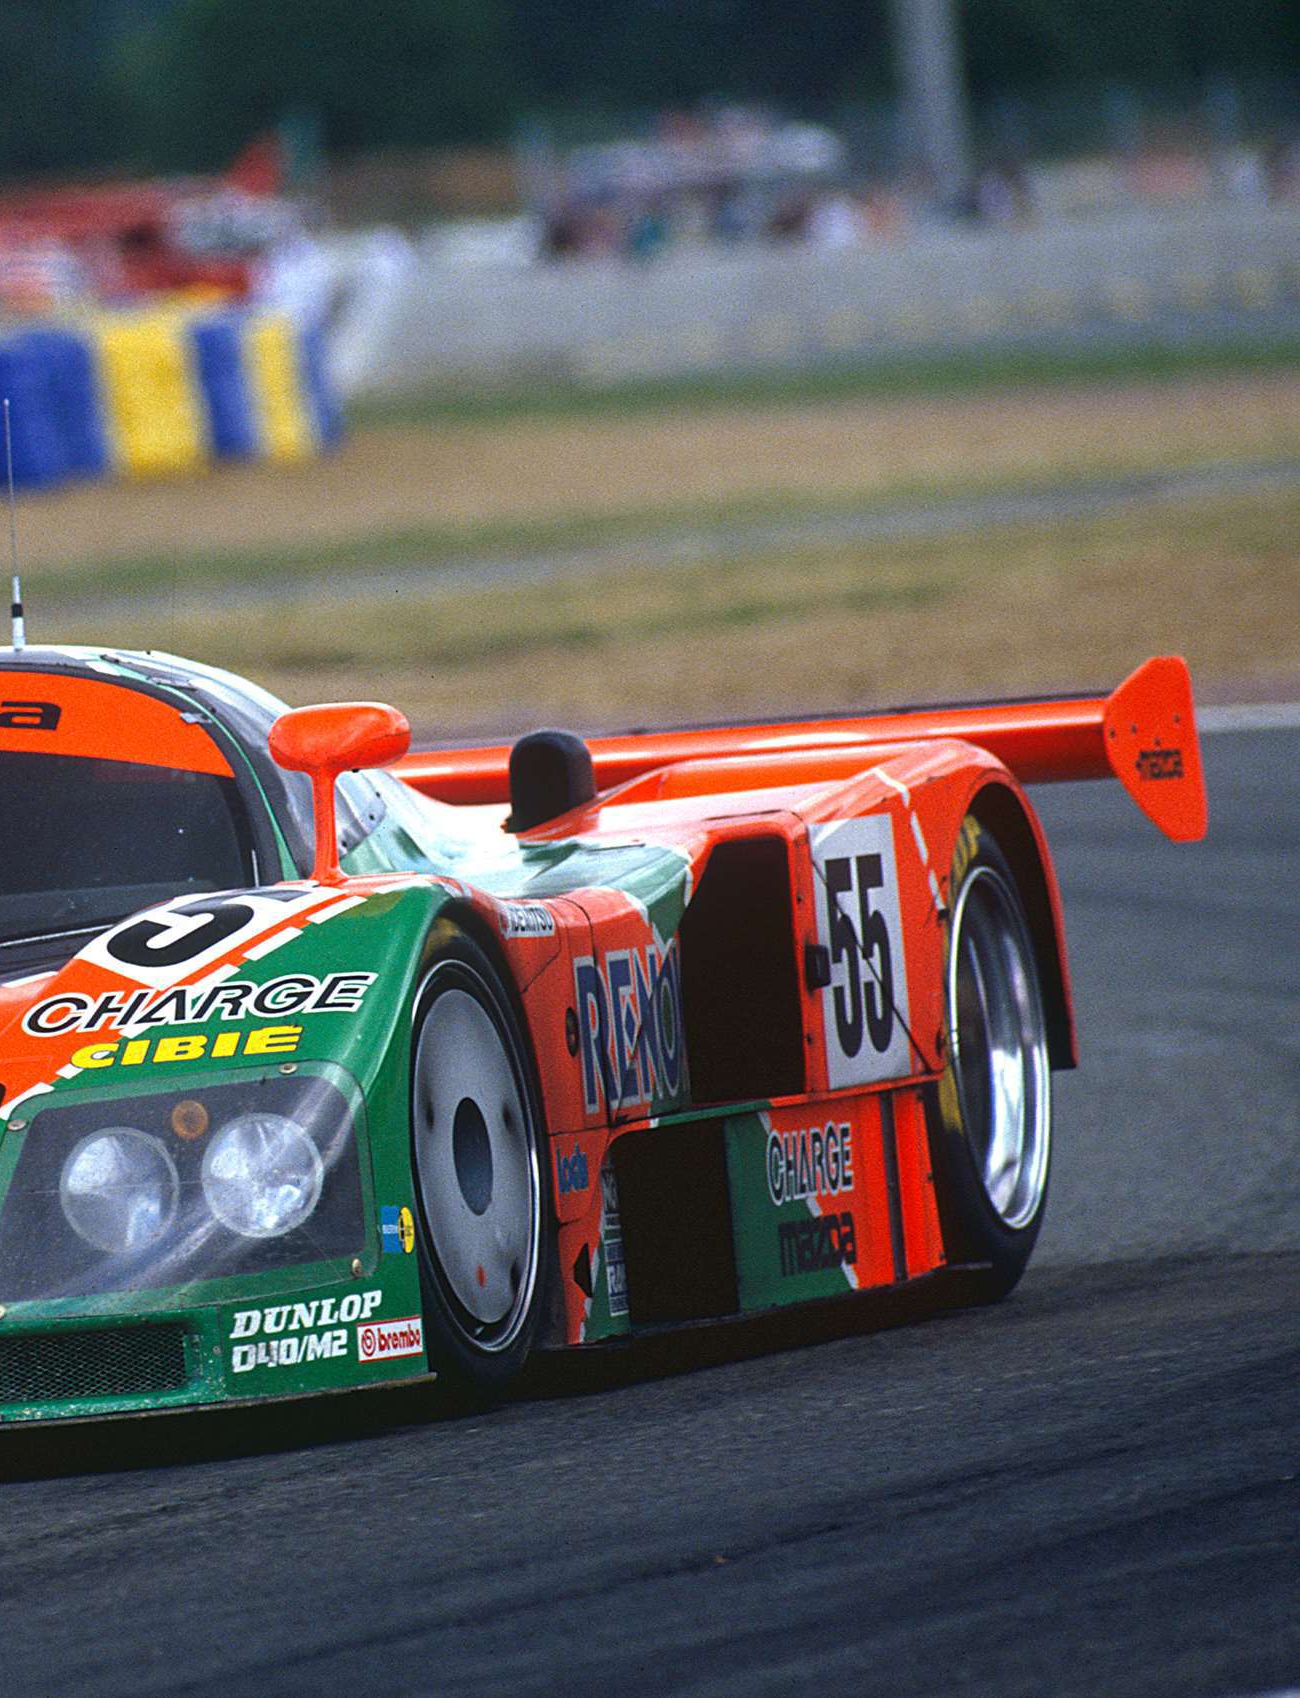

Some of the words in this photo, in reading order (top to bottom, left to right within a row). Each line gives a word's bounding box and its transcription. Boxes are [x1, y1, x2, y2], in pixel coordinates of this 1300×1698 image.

[824, 853, 894, 1058] 55
[21, 971, 379, 1037] CHARGE
[766, 1120, 854, 1206] CHARGE
[229, 1290, 382, 1339] DUNLOP
[377, 1324, 420, 1352] brembo
